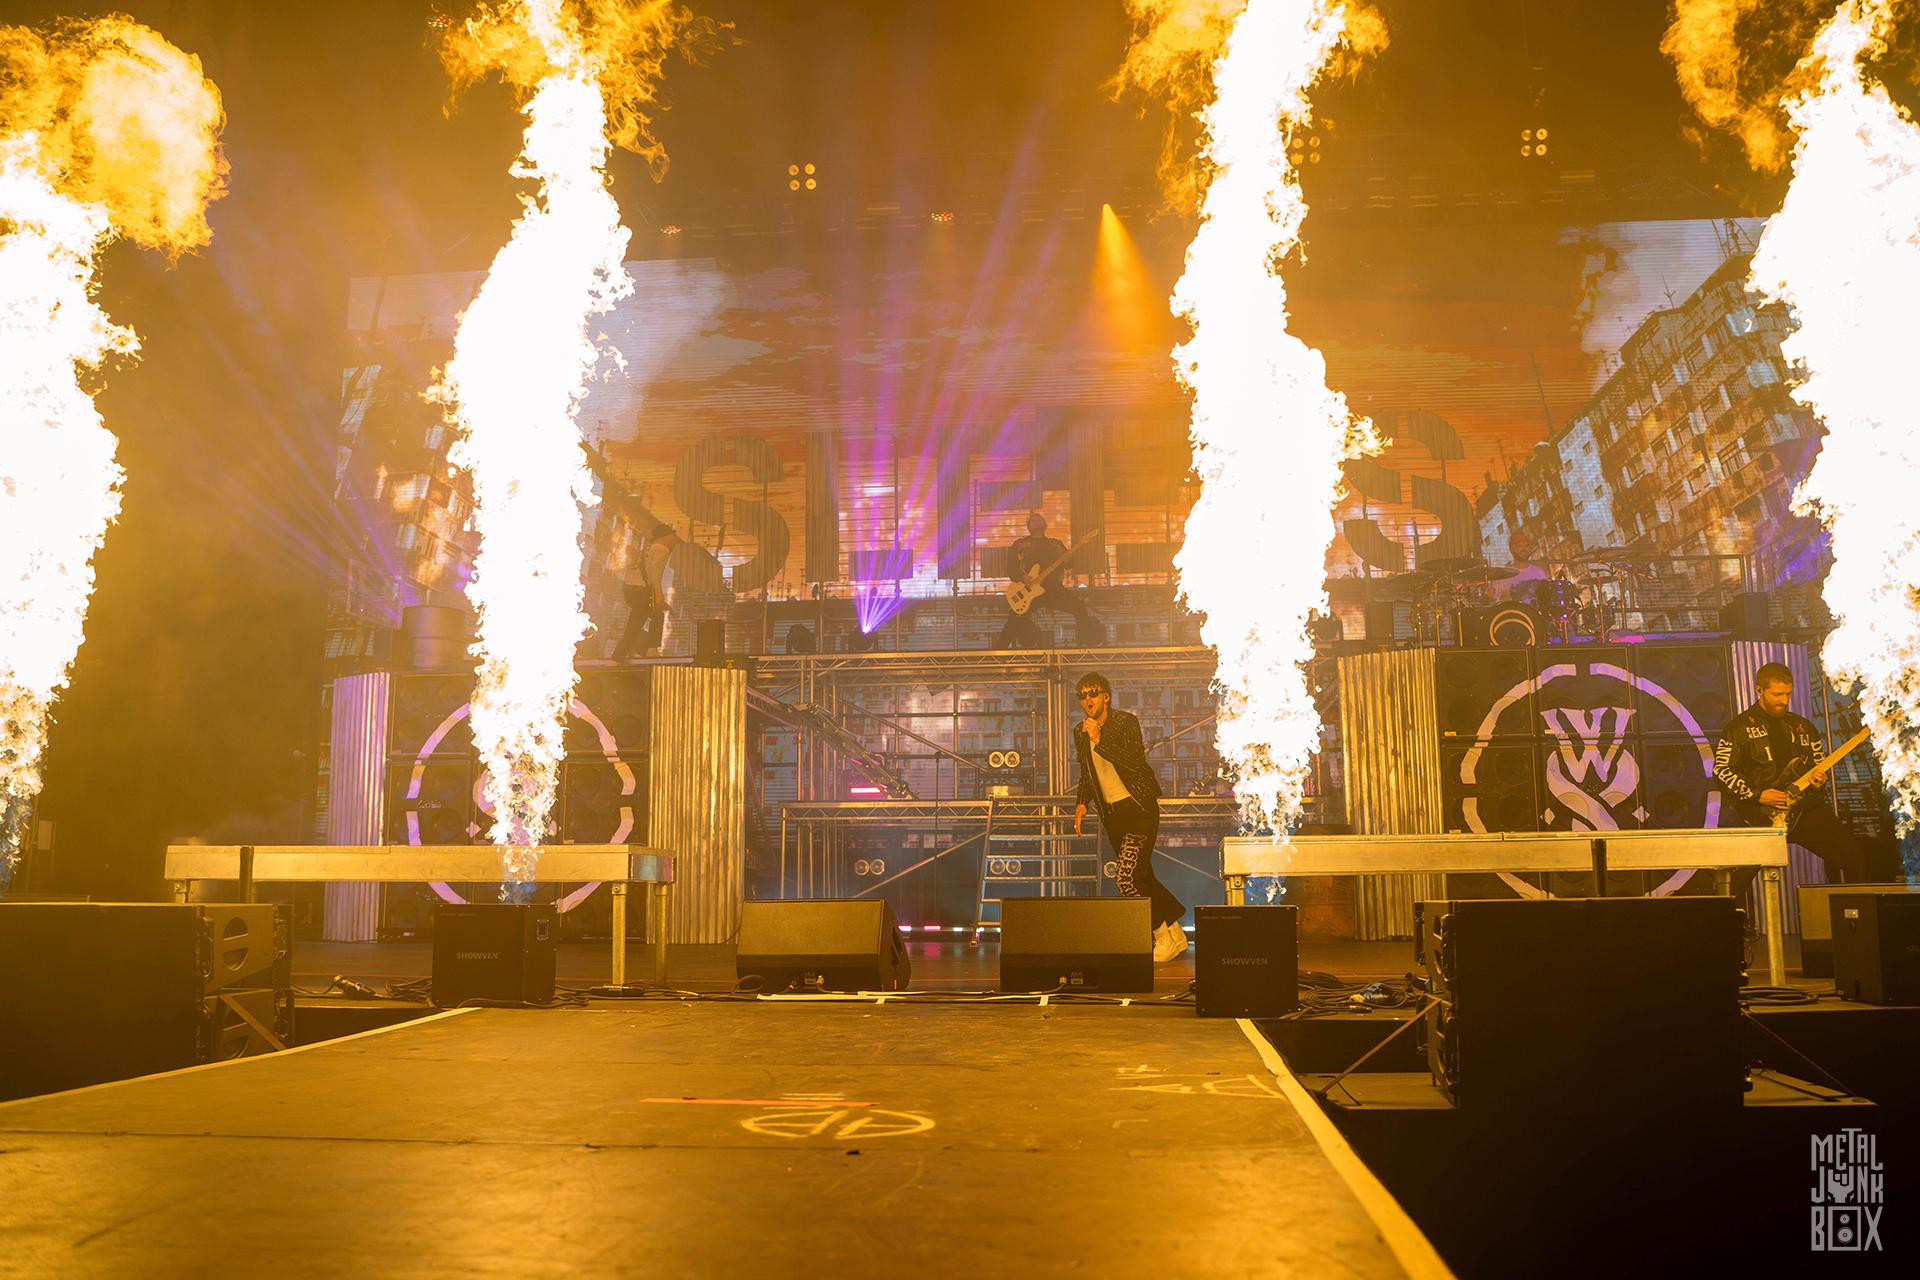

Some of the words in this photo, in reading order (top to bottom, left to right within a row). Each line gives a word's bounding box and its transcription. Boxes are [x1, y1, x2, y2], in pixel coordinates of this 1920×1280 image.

[671, 410, 1474, 593] SLEES
[456, 952, 499, 960] SHOWVEN
[1221, 957, 1268, 966] SHOWVEN
